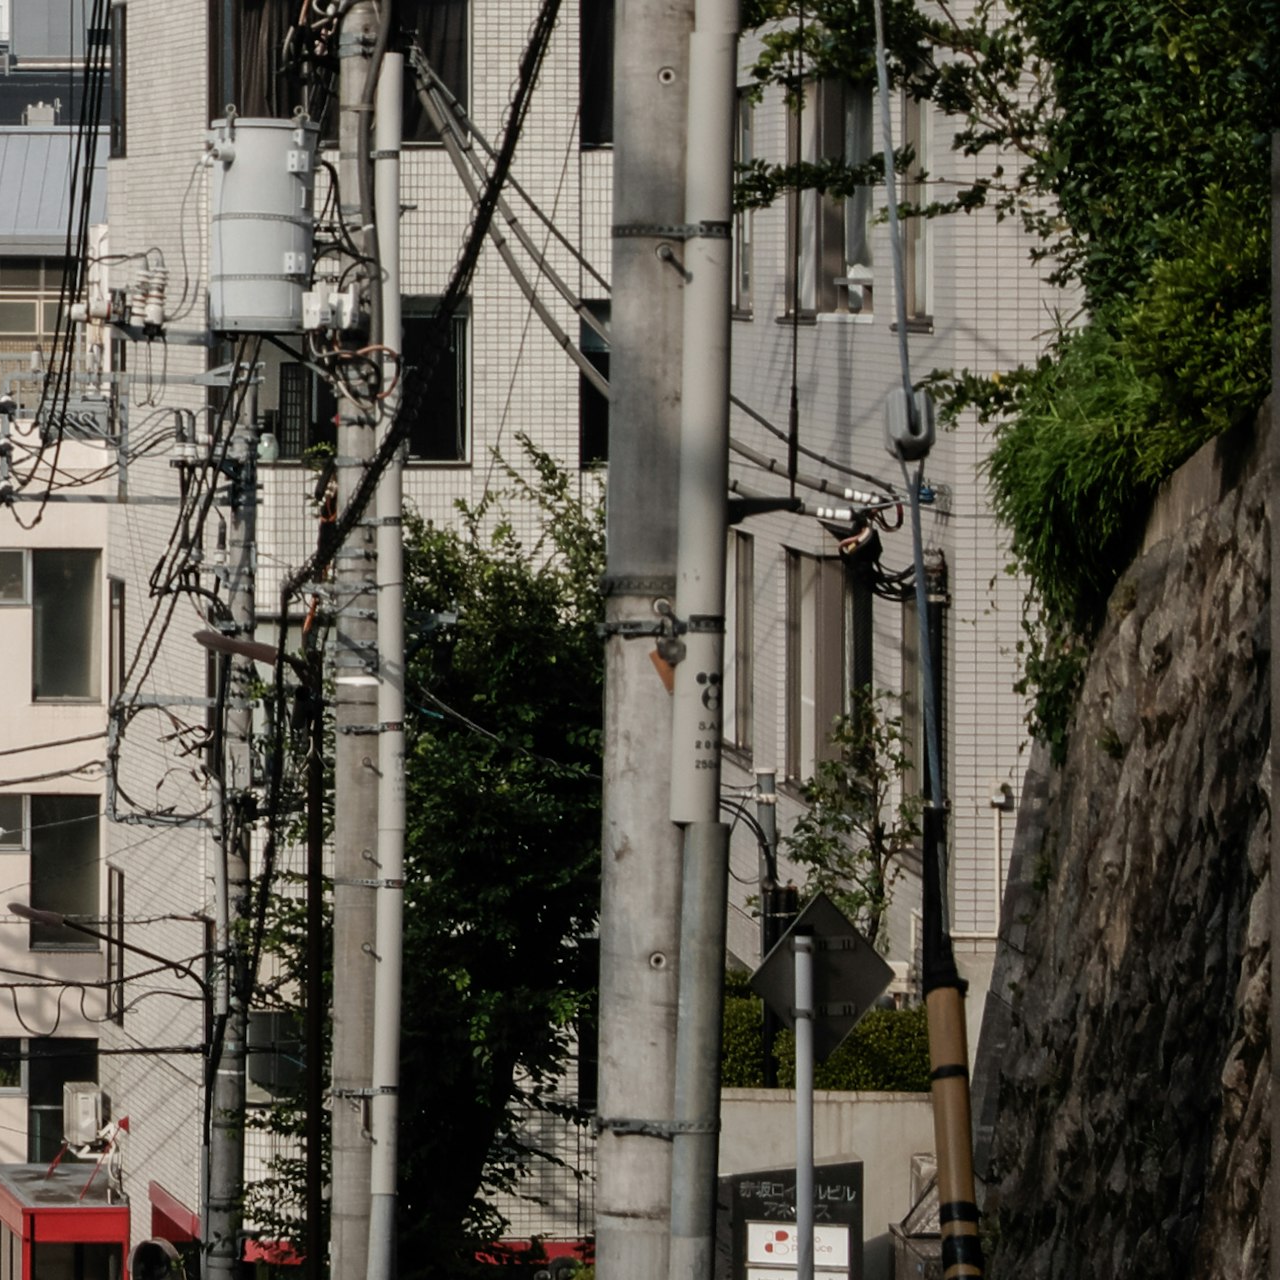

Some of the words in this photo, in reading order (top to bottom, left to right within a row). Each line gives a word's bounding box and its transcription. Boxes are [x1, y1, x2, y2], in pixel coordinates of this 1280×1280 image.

[739, 1180, 857, 1203] 赤坂ロイルビル
